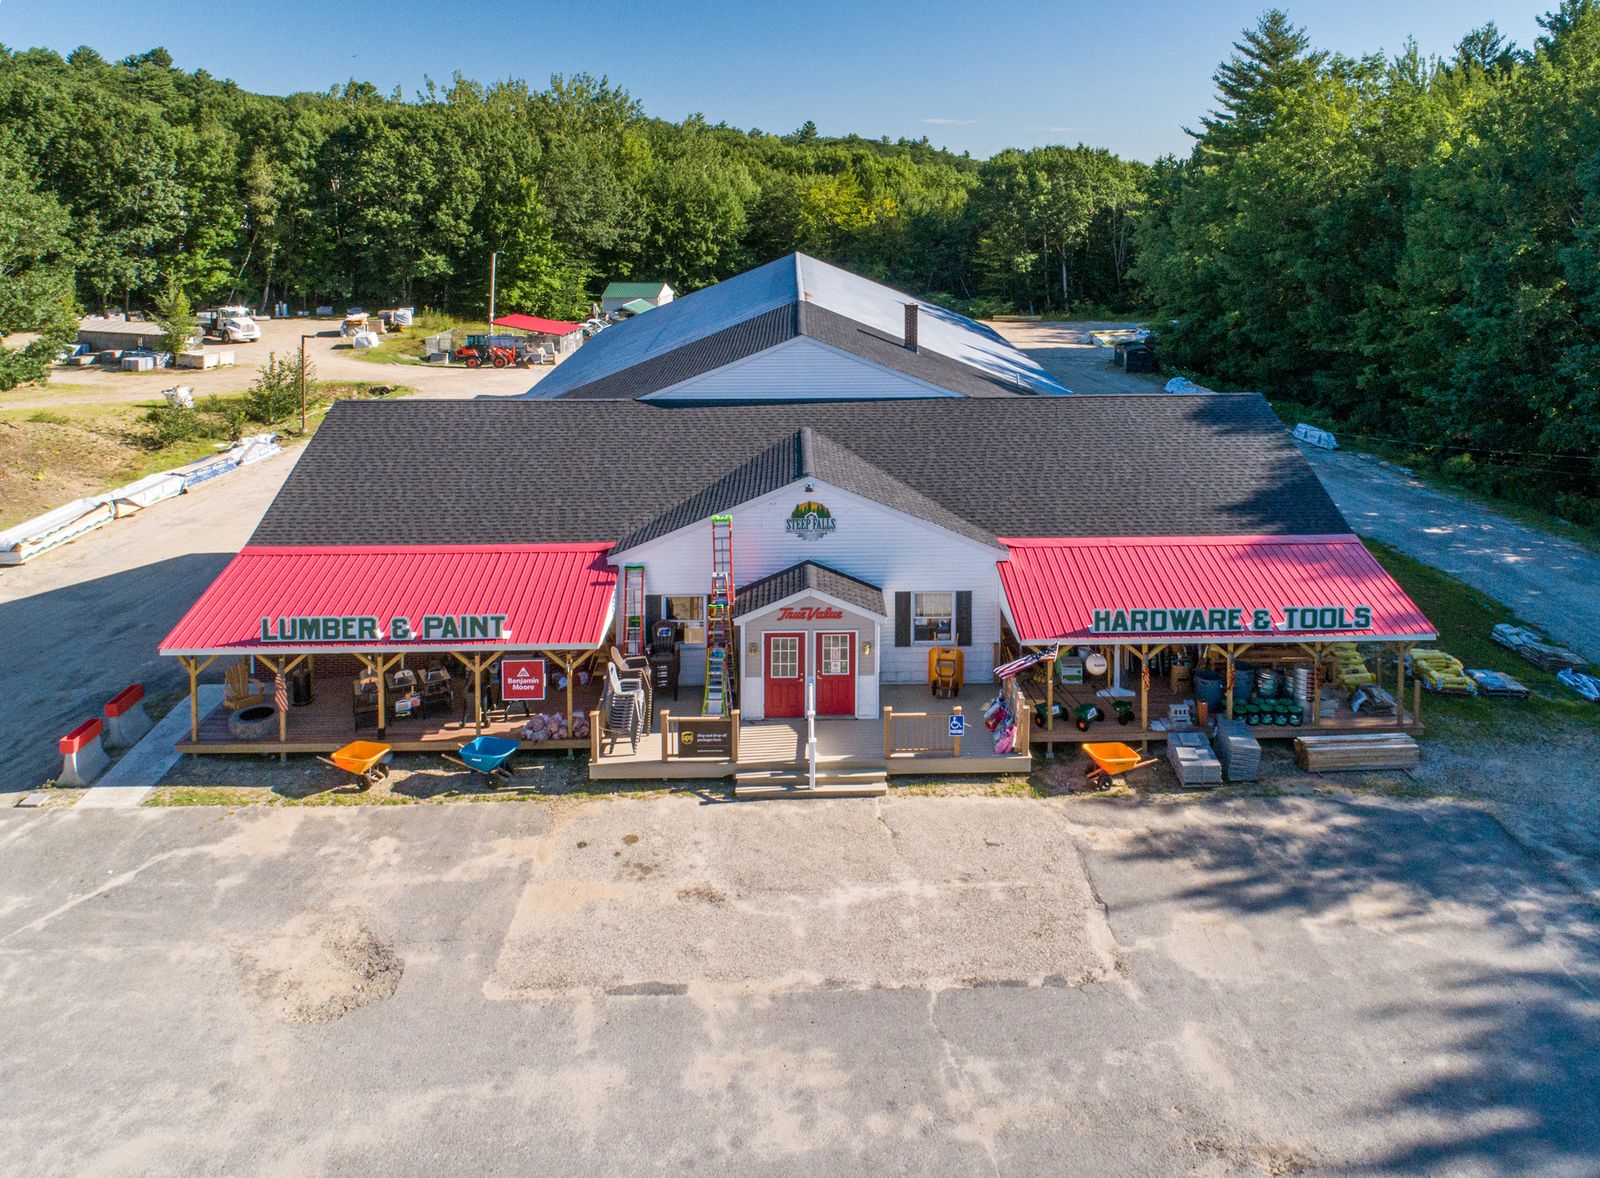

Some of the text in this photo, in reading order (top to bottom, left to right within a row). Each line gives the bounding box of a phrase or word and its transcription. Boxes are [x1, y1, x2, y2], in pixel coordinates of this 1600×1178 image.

[786, 518, 836, 530] STEEP FALLS
[776, 607, 843, 621] True Value
[1093, 606, 1371, 632] HARDWARE & TOOLS
[261, 615, 506, 641] LUMBER & PAINT
[507, 677, 539, 685] Benjamin
